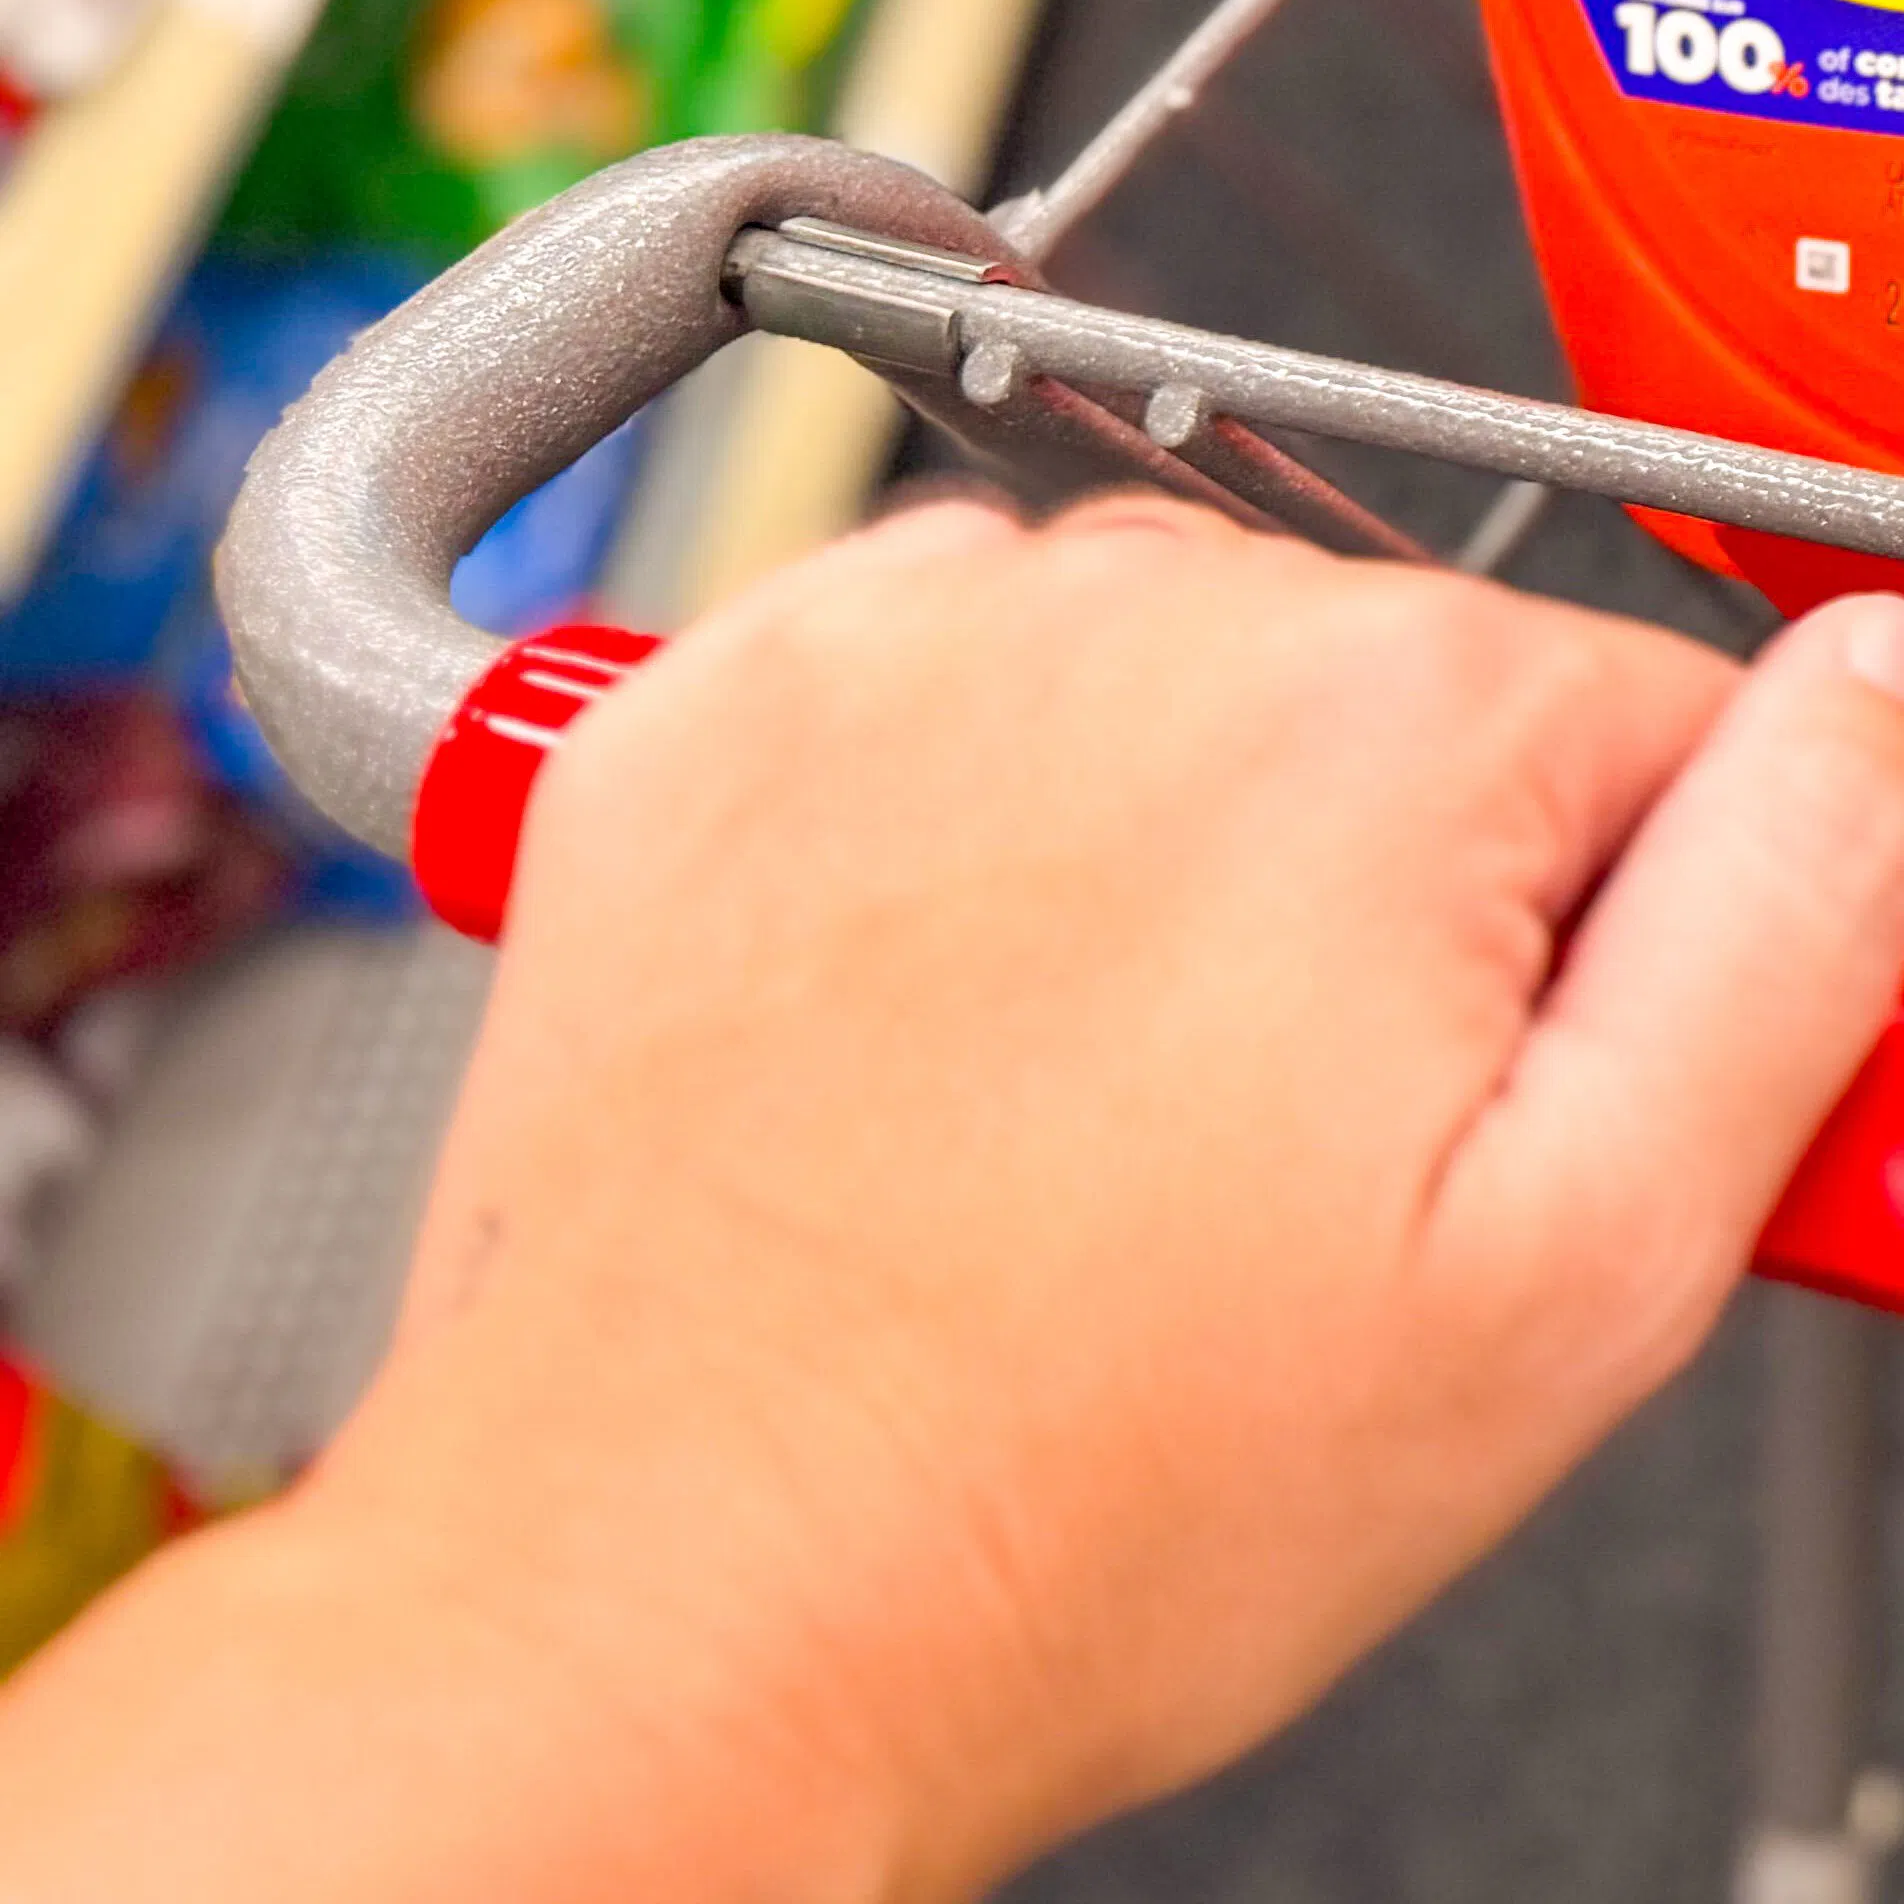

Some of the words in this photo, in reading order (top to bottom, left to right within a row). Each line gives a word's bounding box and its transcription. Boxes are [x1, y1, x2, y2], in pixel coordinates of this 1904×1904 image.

[1613, 0, 1811, 100] 100%
[1817, 45, 1852, 73] of
[1817, 77, 1871, 106] des
